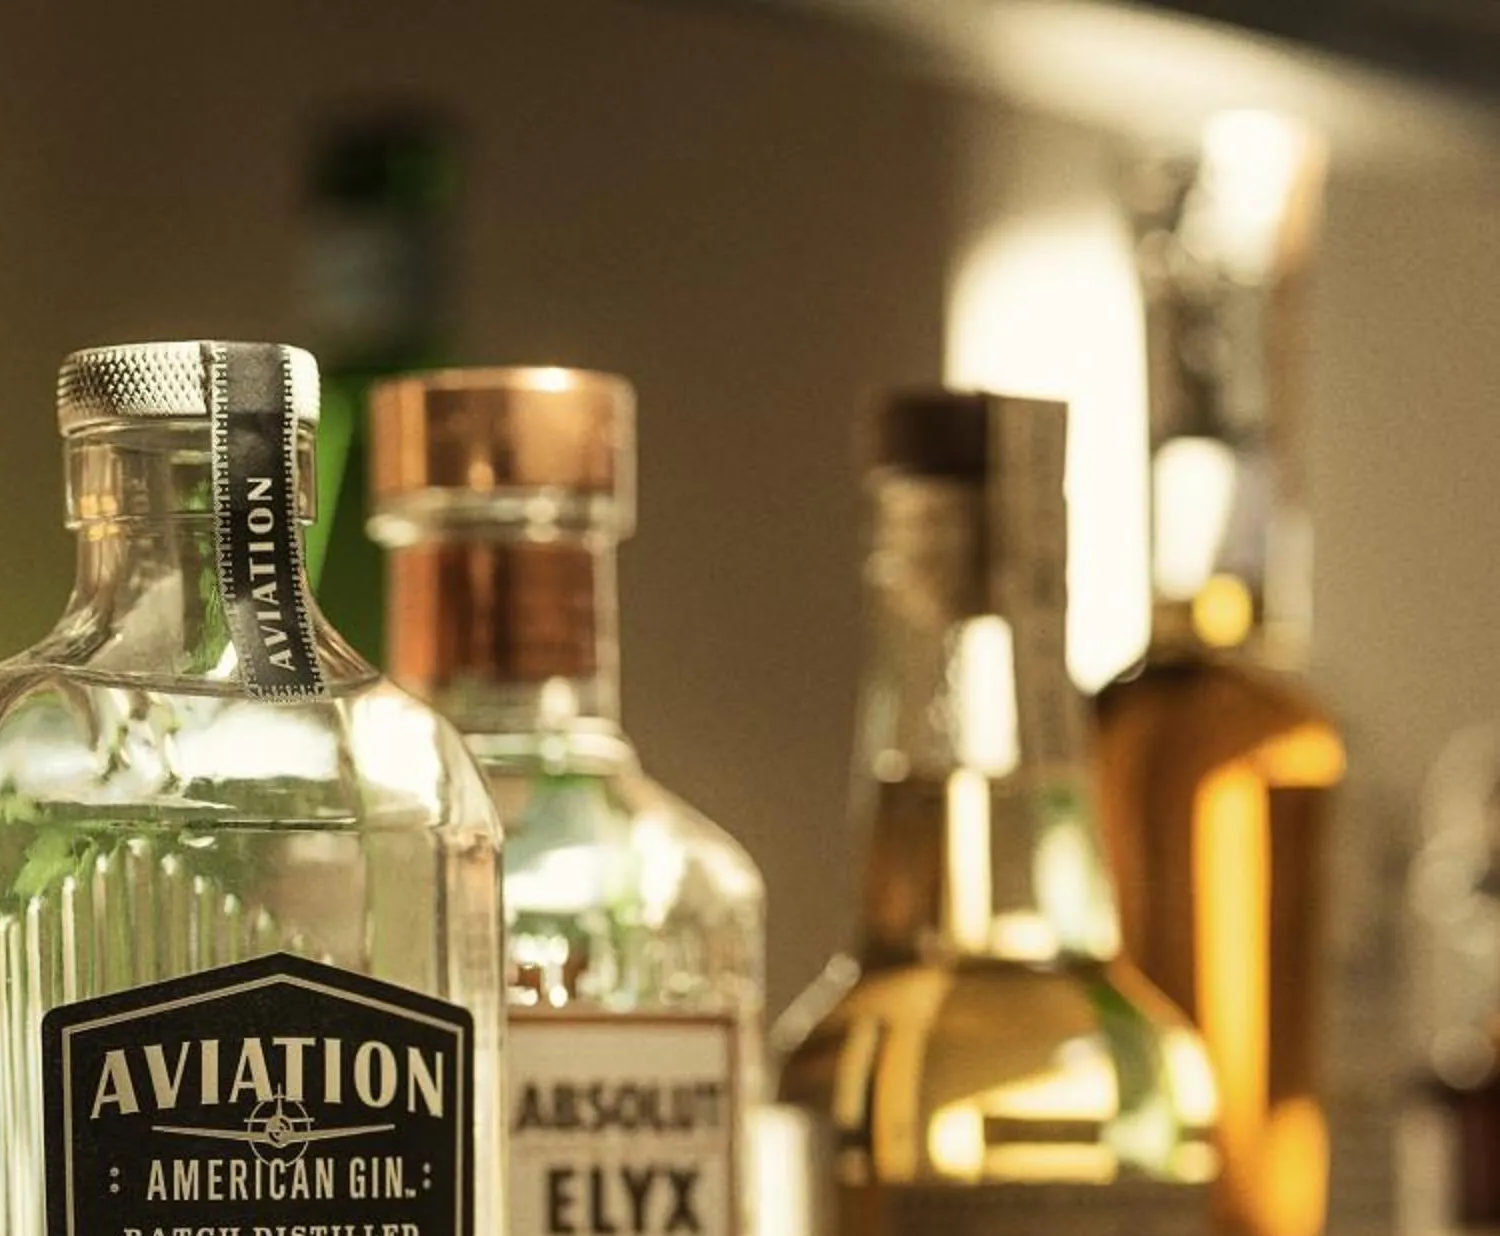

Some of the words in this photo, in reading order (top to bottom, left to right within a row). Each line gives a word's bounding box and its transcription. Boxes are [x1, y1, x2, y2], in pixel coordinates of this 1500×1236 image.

[247, 477, 296, 671] AVIATION
[89, 1037, 444, 1119] AVIATION
[147, 1157, 333, 1200] AMERICAN
[545, 1167, 703, 1236] ELYX
